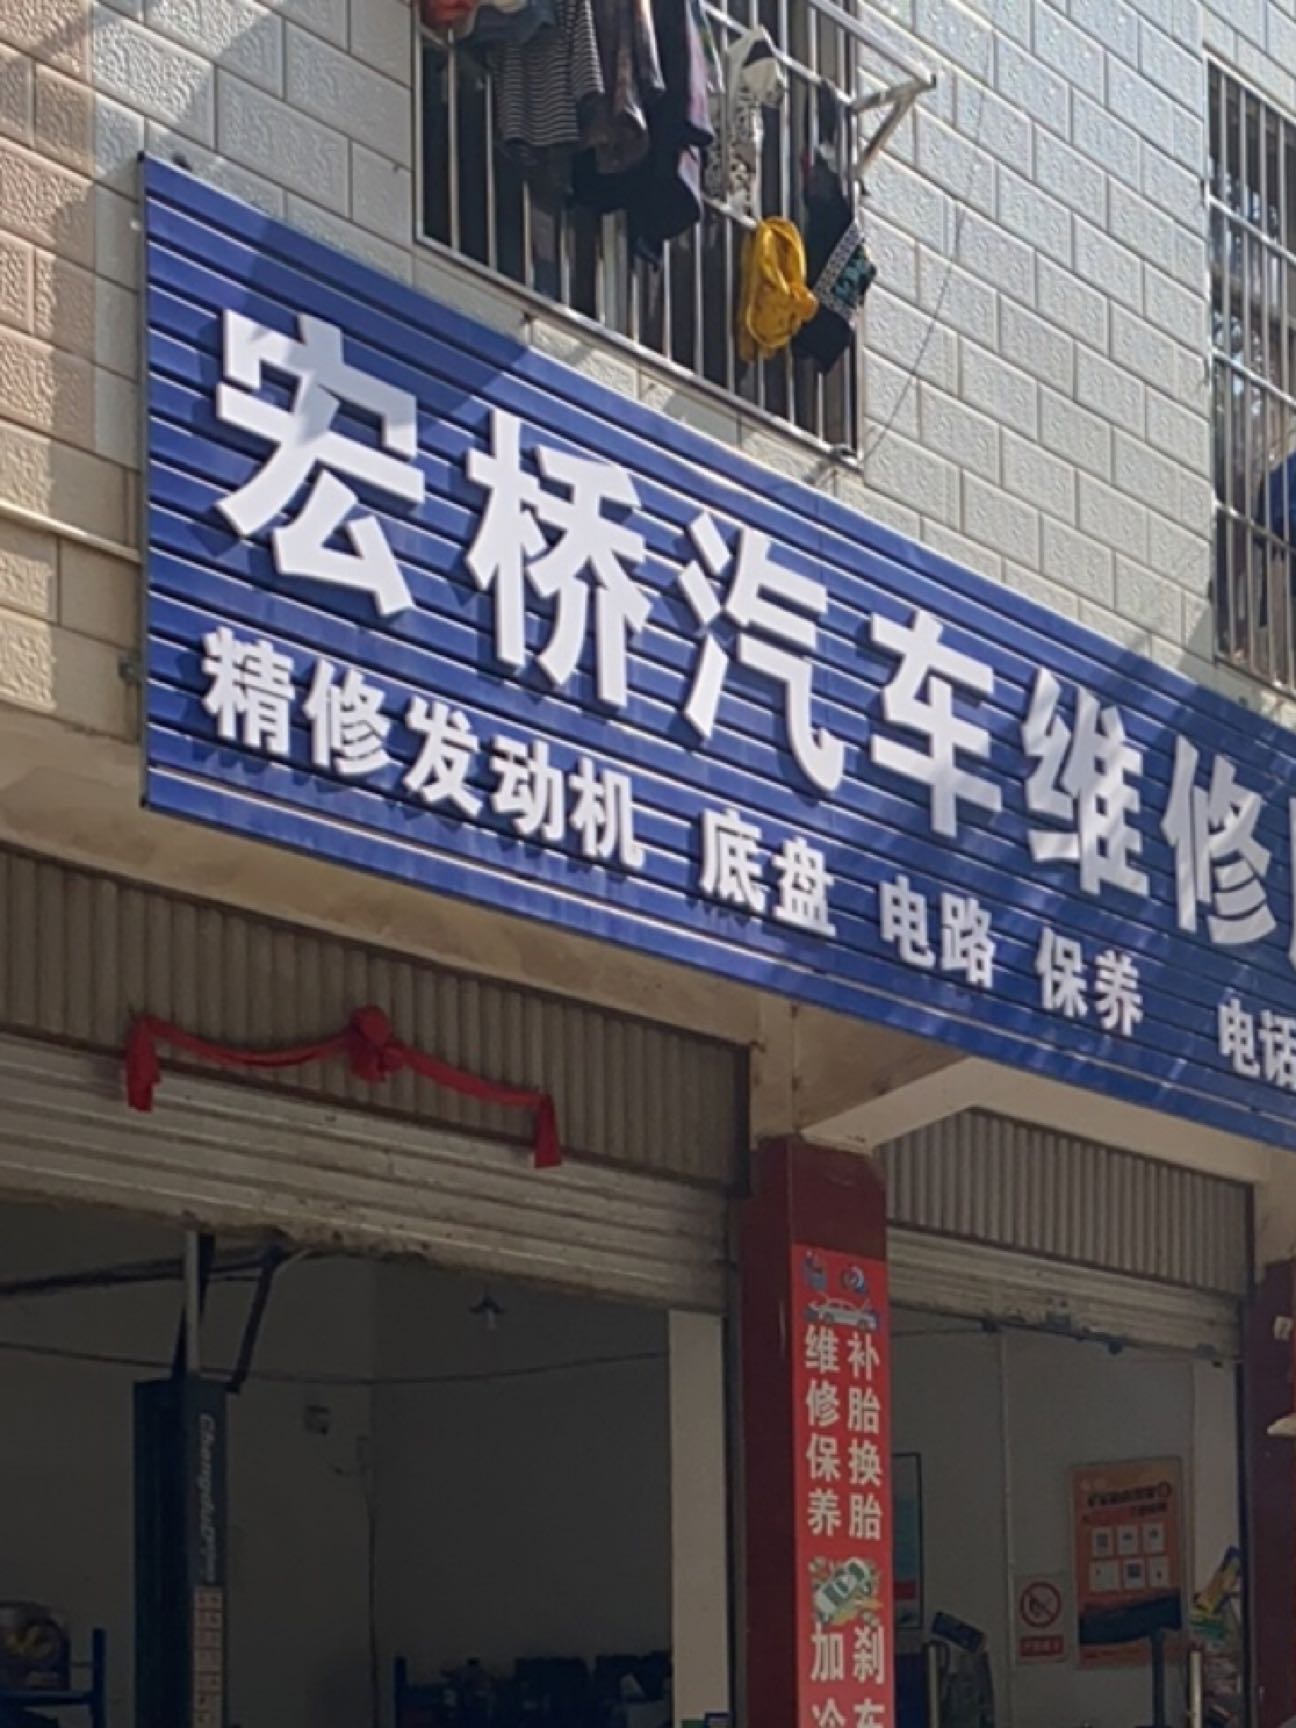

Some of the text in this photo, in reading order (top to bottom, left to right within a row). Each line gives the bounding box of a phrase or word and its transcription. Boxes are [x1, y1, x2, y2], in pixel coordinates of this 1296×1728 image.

[202, 627, 645, 869] 精修发动机
[700, 808, 836, 935] 底盘
[879, 876, 994, 988] 电路
[1036, 928, 1144, 1036] 保养
[805, 1325, 841, 1537] 维修保养
[848, 1332, 884, 1540] 补胎换胎
